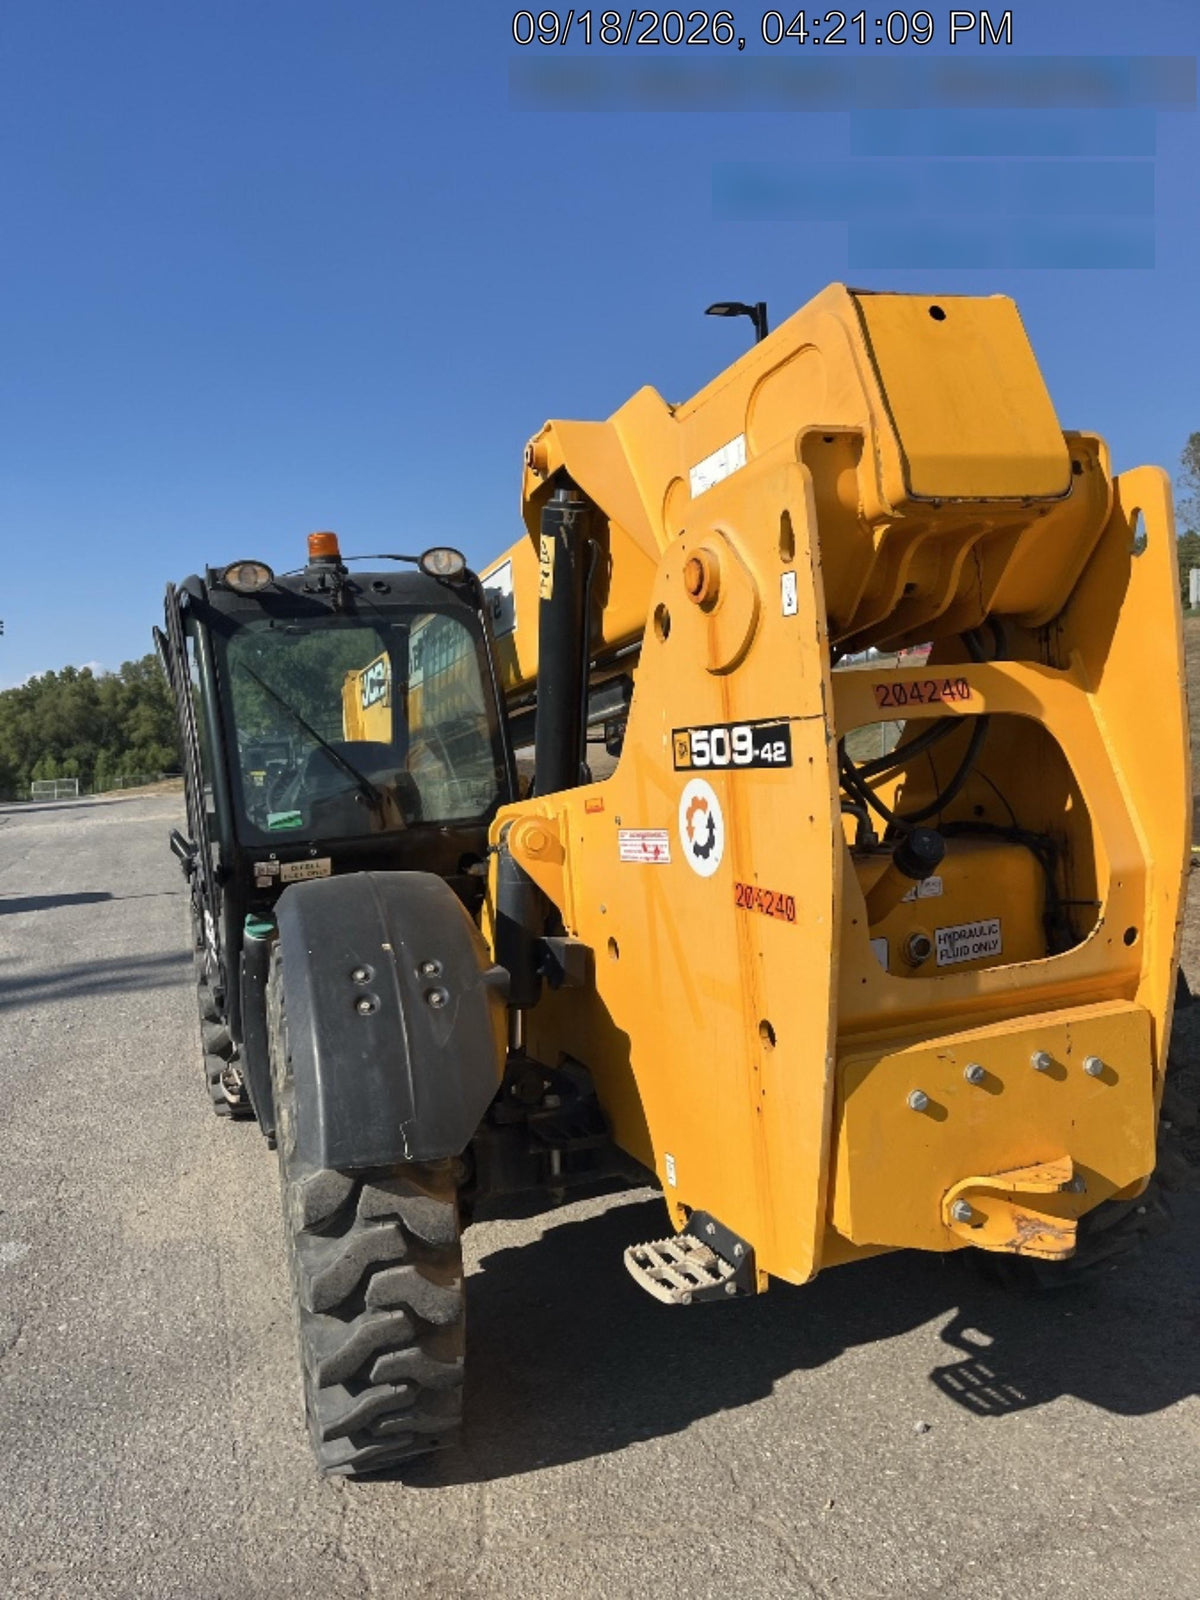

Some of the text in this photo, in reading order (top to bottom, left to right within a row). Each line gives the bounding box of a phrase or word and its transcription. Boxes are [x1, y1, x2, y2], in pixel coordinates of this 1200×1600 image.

[876, 677, 971, 707] 204240
[735, 882, 796, 922] 204240
[938, 923, 999, 945] HYDRAULIC
[940, 939, 999, 961] FLUID ONLY
